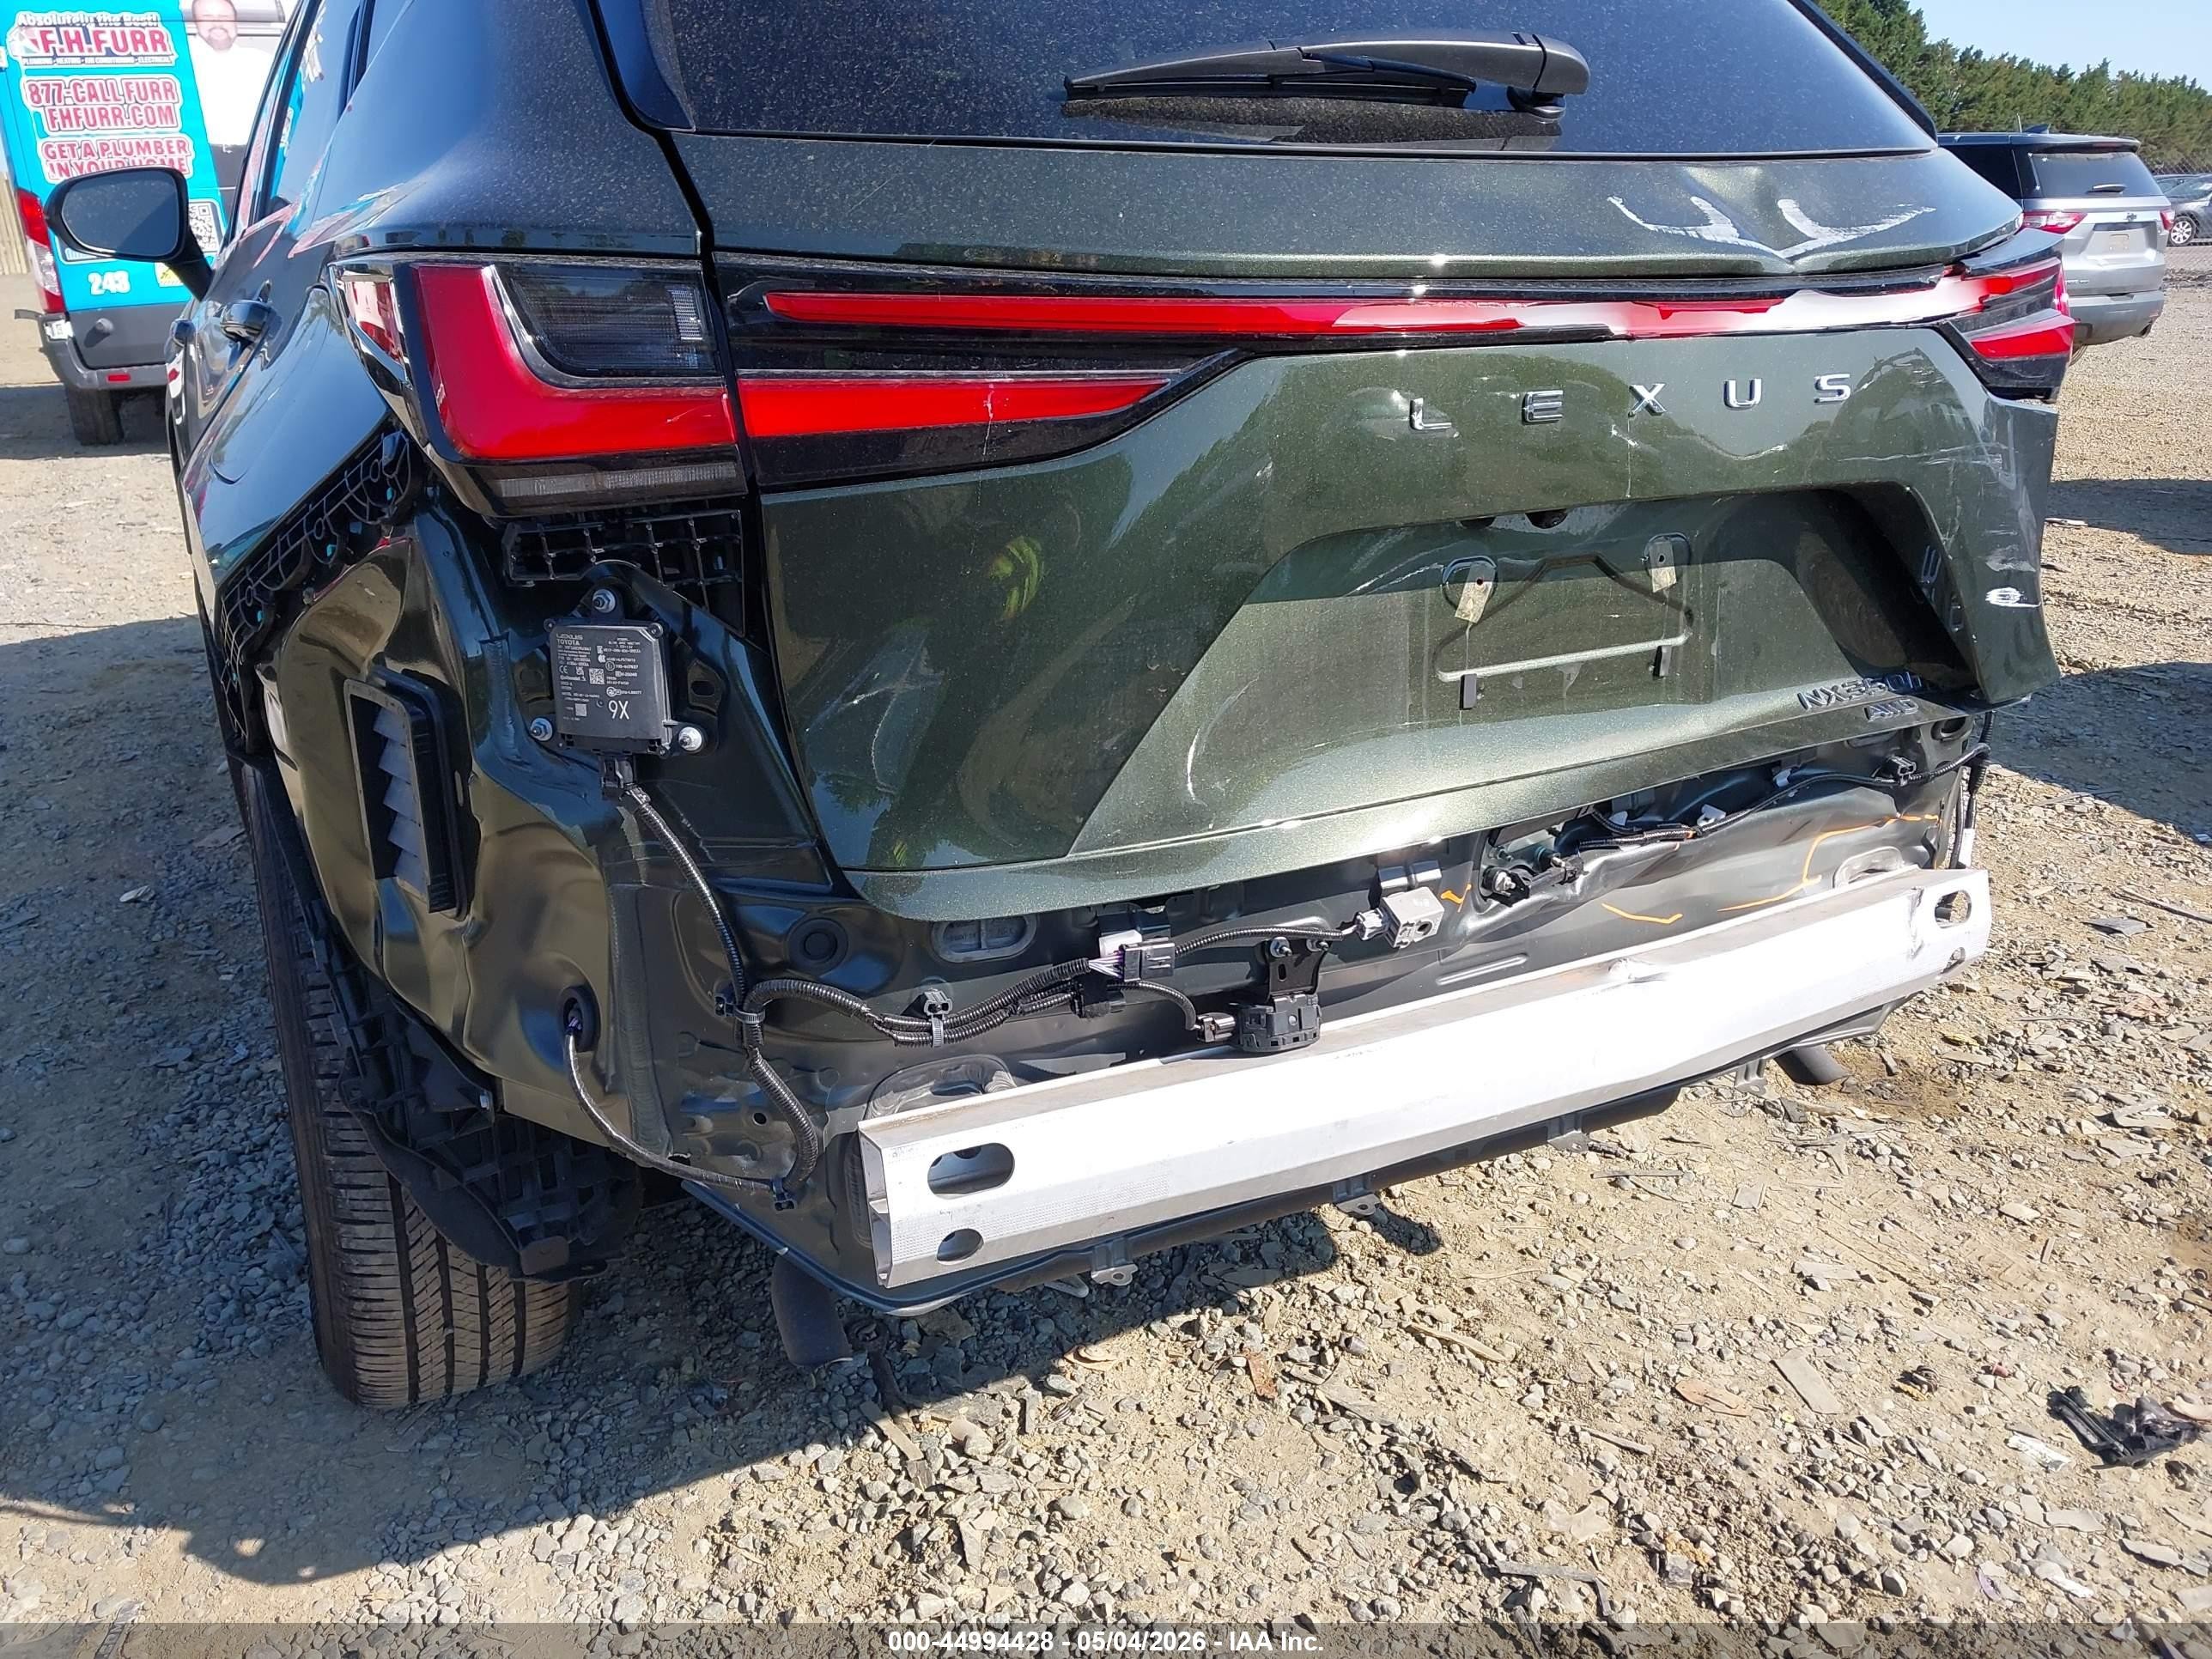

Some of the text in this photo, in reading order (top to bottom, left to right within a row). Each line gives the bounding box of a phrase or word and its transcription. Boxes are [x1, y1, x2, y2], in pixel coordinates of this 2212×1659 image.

[17, 13, 94, 28] Absolutely
[95, 14, 121, 27] the
[28, 80, 177, 104] 877-CALL FURR
[47, 105, 176, 129] FHFURR.COM
[44, 139, 189, 160] GET A PLUMBER
[49, 161, 70, 178] IN
[88, 271, 131, 295] 243
[608, 700, 629, 720] 9X
